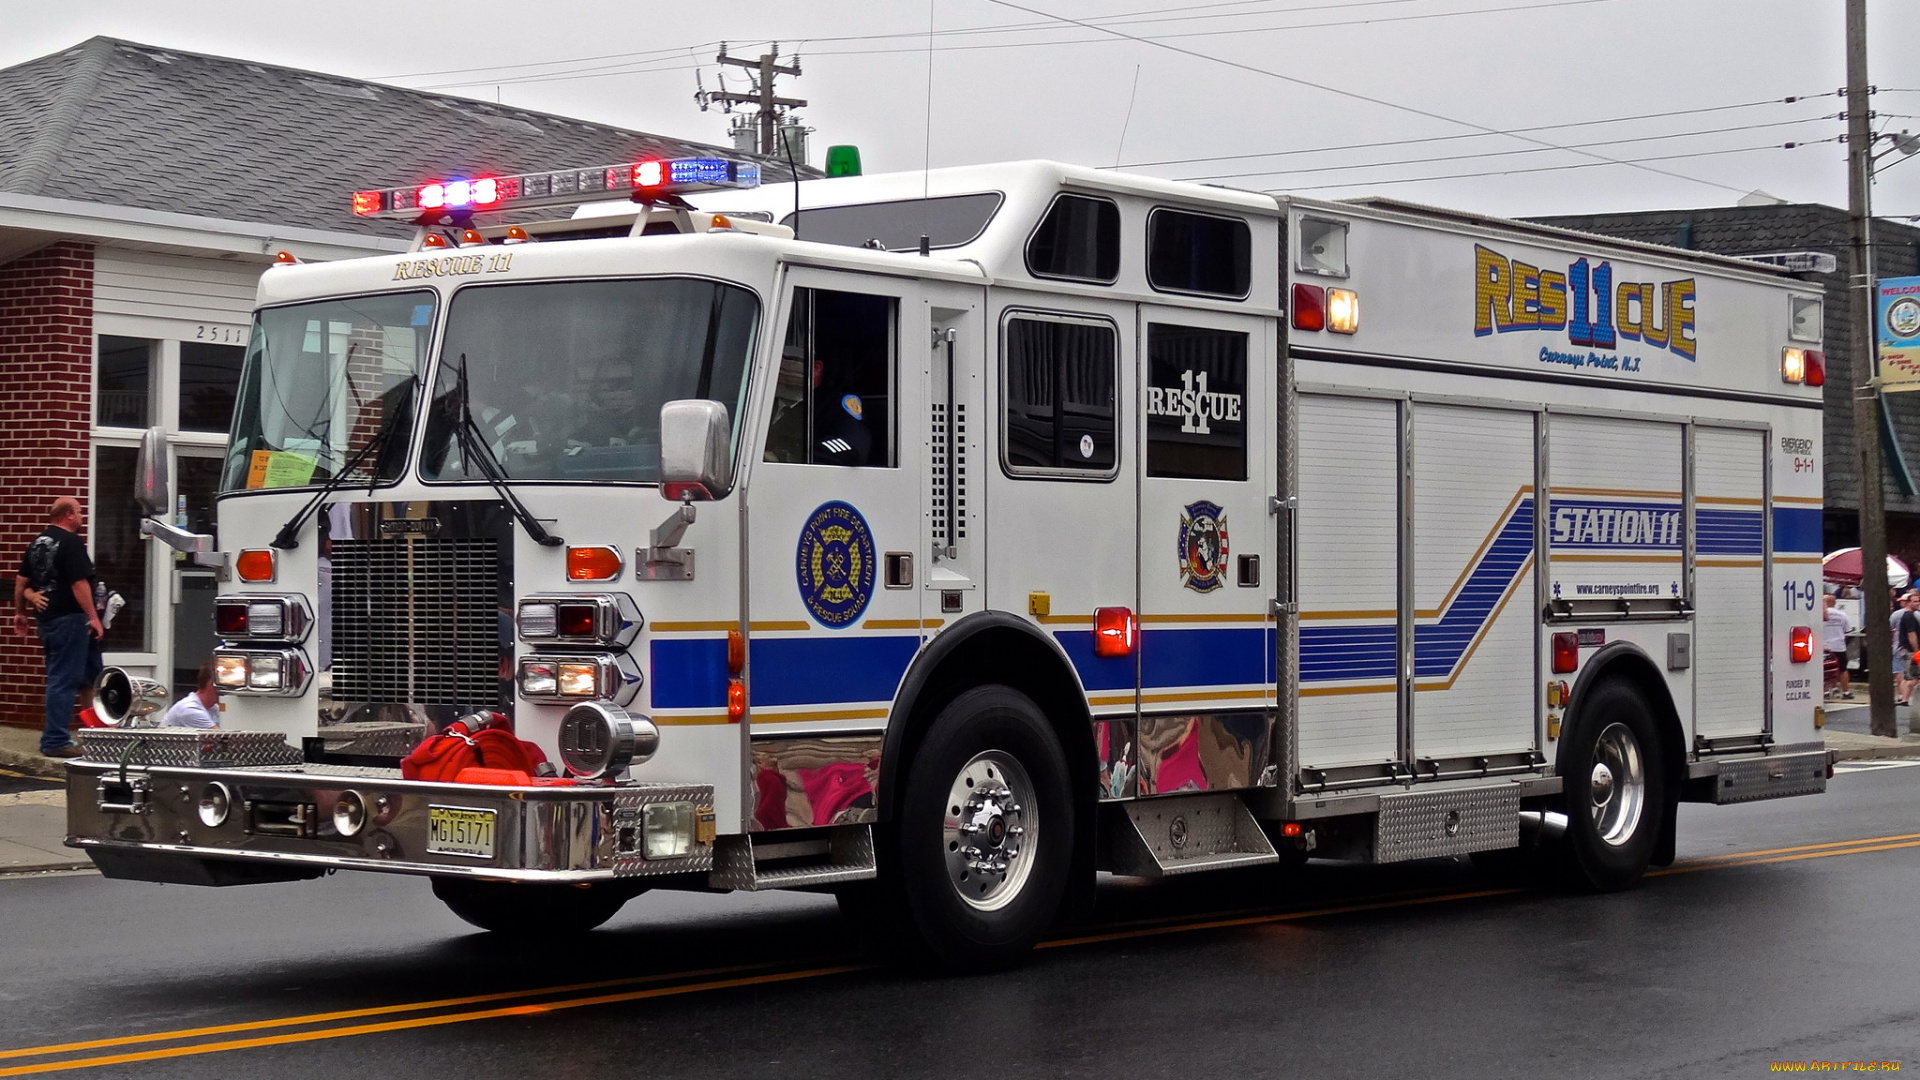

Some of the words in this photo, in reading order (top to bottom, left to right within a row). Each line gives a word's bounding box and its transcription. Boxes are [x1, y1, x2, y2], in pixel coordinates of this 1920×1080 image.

[391, 254, 485, 281] RESCUE
[486, 253, 513, 273] 11
[197, 325, 241, 343] 2511
[1539, 346, 1585, 370] Carneys
[1587, 351, 1618, 372] Point,
[1147, 386, 1241, 421] RESCUE
[1795, 457, 1814, 473] 9-1-1
[1554, 507, 1656, 544] STATION
[1659, 511, 1680, 544] 11
[800, 530, 813, 586] CARNEYS
[810, 508, 831, 531] POINT
[833, 507, 851, 521] FIRE
[850, 515, 873, 587] DEPARTMENT
[1576, 583, 1659, 596] www.carneyspointfire.org
[1783, 580, 1815, 611] 11-9
[813, 602, 842, 622] RESCUE
[843, 593, 866, 621] SQUAD
[430, 819, 490, 846] MG15171
